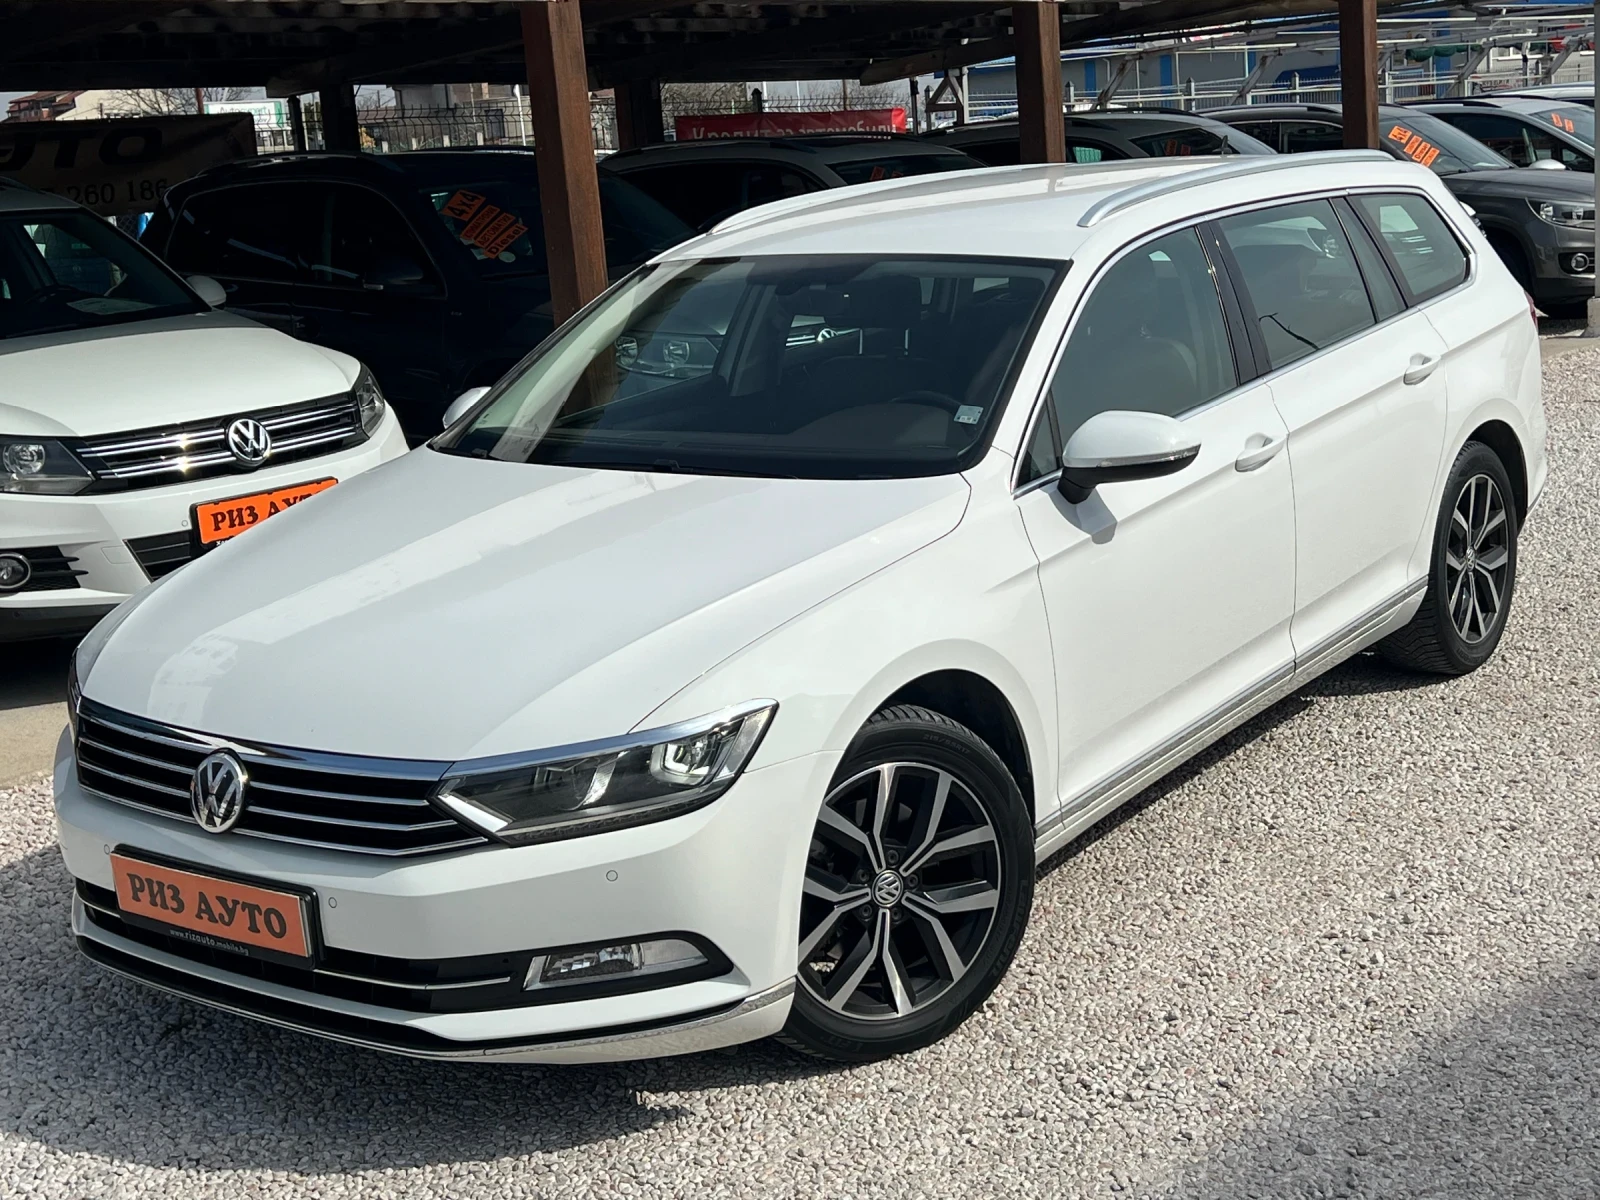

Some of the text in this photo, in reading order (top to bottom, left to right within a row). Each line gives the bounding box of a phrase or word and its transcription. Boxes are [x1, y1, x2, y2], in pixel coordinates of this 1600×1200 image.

[67, 183, 114, 204] 260
[488, 223, 525, 255] Diesel
[211, 505, 259, 532] РИЗ
[126, 873, 287, 939] РИЗ АУТО
[170, 928, 249, 956] www.rizauto.mobile.bg
